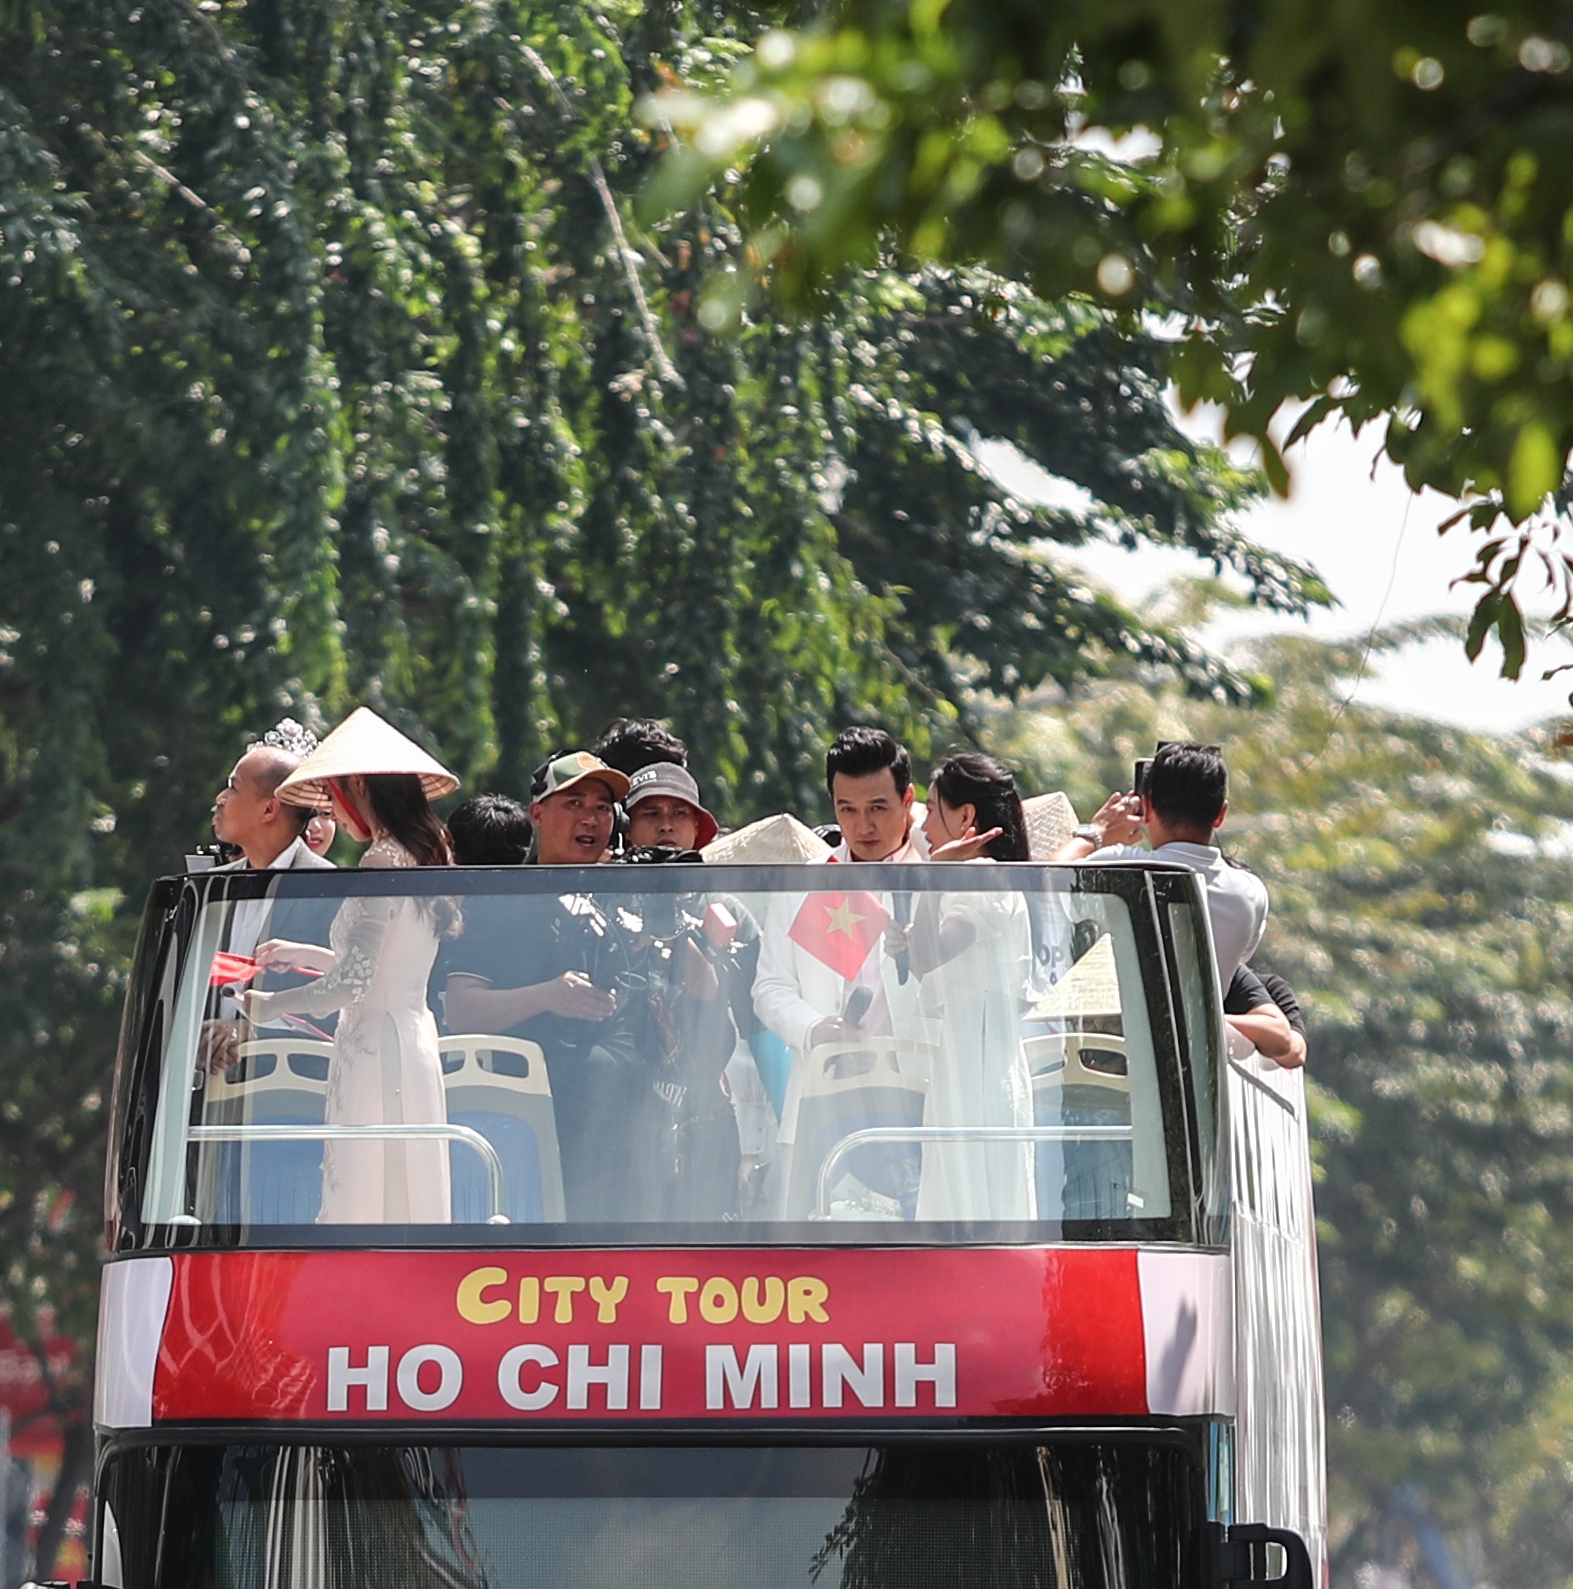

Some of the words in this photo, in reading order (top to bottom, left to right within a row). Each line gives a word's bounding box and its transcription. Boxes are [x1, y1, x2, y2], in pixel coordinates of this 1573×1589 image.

[456, 1266, 628, 1325] CITY
[657, 1276, 830, 1325] TOUR
[325, 1344, 463, 1412] HO
[497, 1344, 663, 1411] CHI
[704, 1342, 956, 1409] MINH
